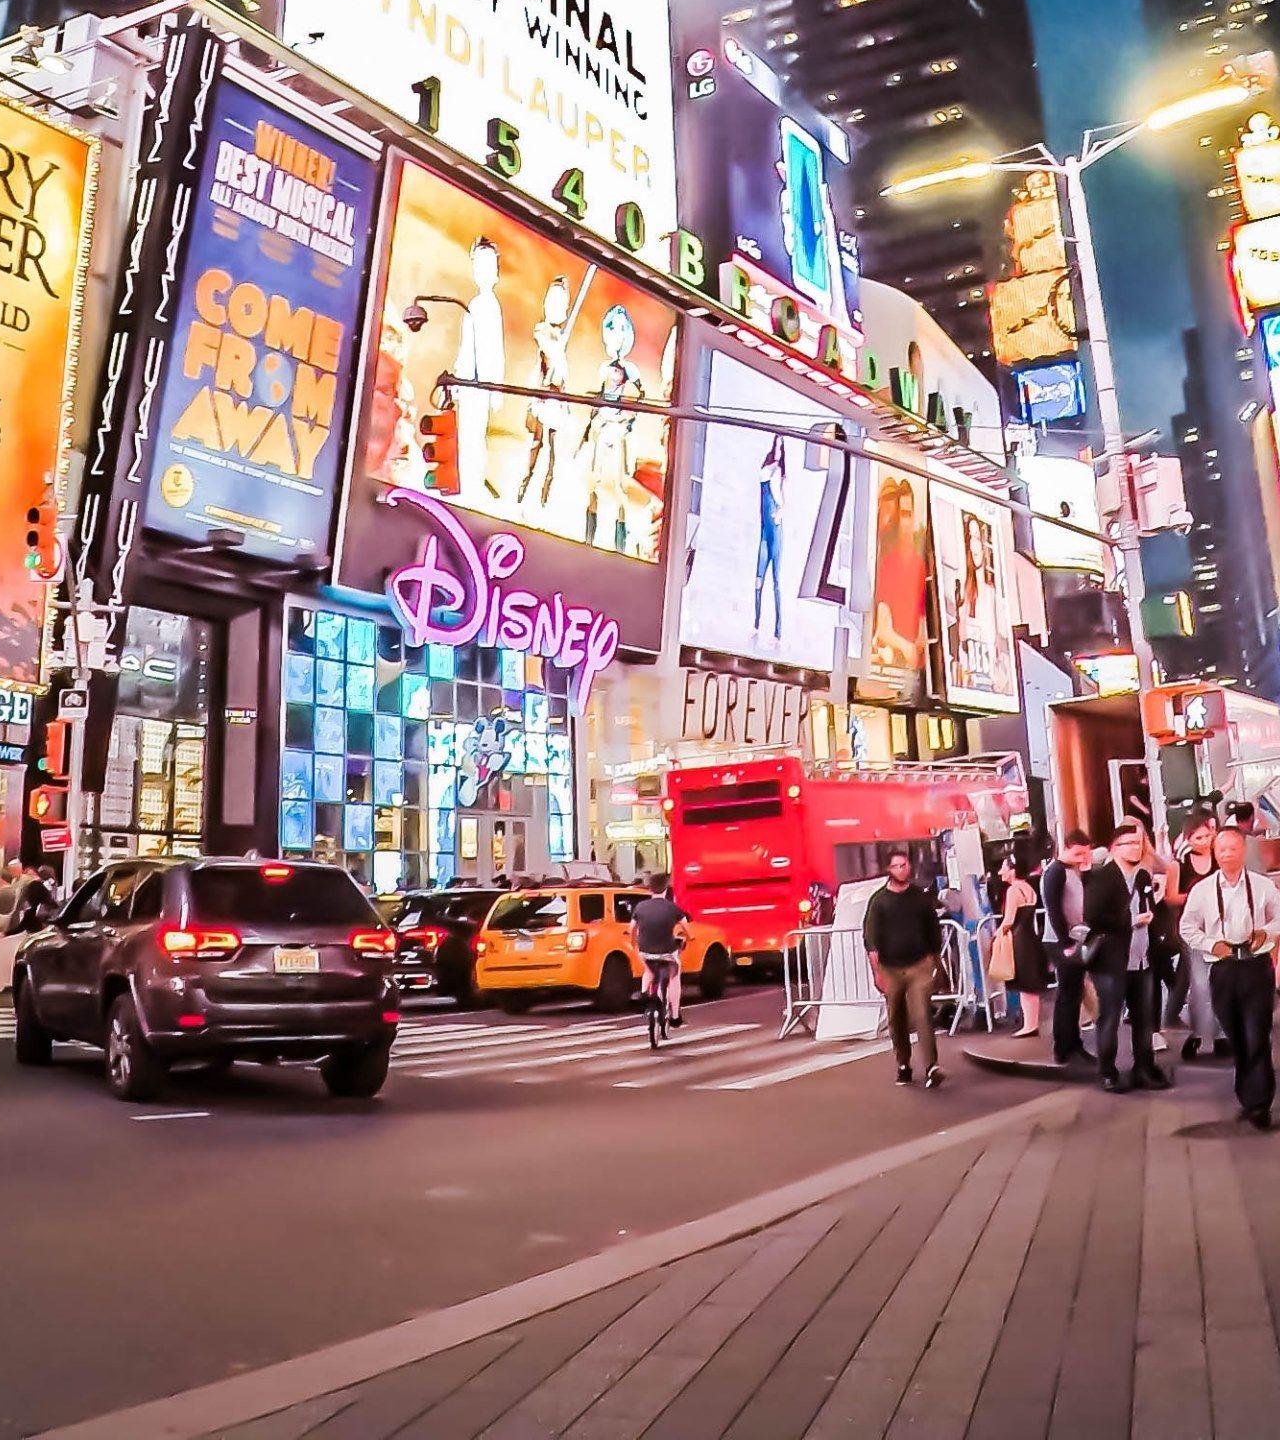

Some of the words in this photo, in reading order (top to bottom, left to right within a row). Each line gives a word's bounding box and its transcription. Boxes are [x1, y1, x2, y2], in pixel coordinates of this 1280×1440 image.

[501, 44, 653, 190] LAUPER
[523, 6, 649, 121] WINNING
[214, 139, 272, 201] BEST
[270, 168, 356, 248] MUSICAL
[192, 267, 345, 372] COME
[170, 384, 333, 480] AWAY
